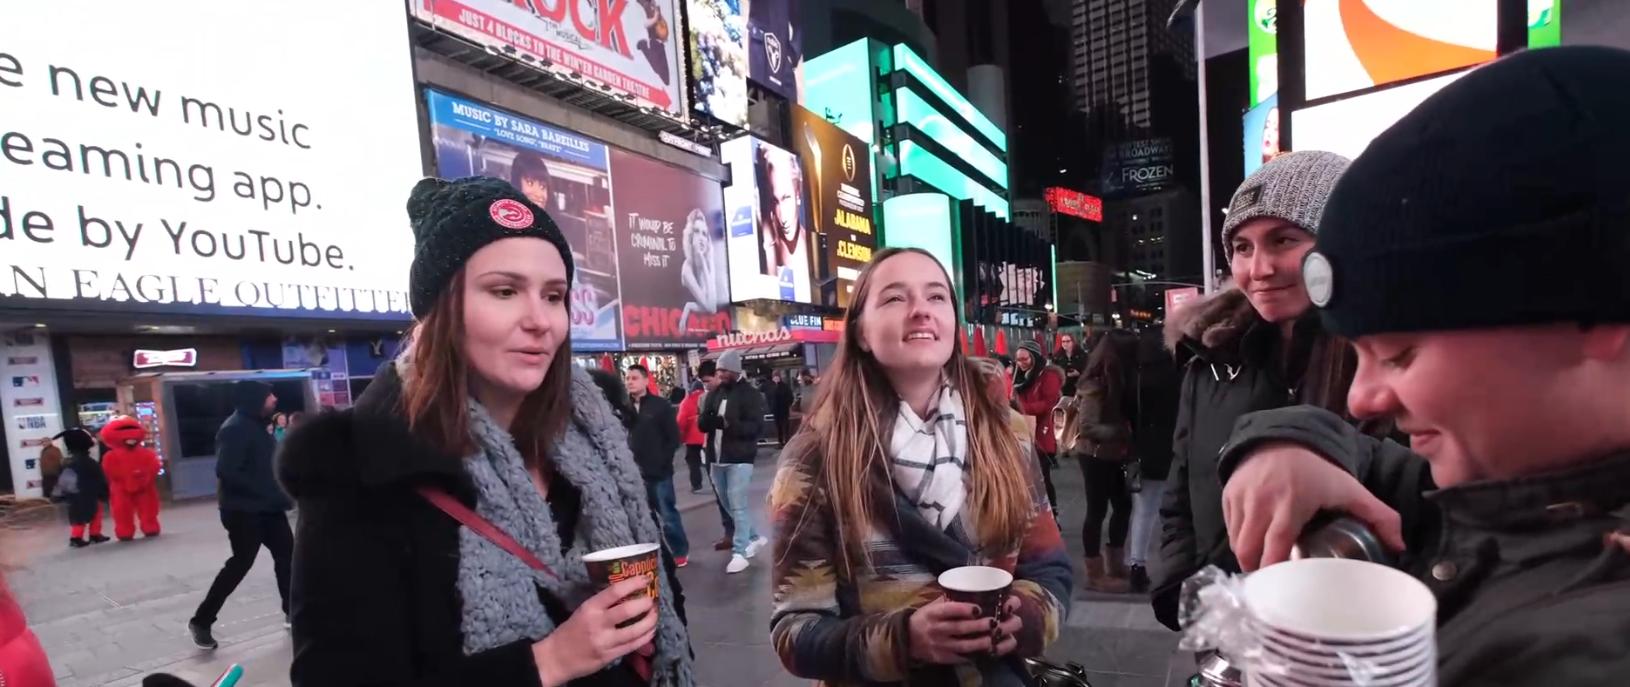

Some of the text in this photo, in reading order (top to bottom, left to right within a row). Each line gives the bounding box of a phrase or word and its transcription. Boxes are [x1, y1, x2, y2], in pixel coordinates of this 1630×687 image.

[458, 9, 484, 33] JUST
[486, 20, 495, 33] 4
[495, 22, 532, 49] BLOCKS
[533, 40, 545, 56] TO
[545, 43, 562, 64] THE
[49, 63, 161, 117] new
[181, 96, 311, 149] music
[452, 101, 590, 153] MUSIC BY SARA BAREILLES
[1122, 164, 1173, 183] FROZEN
[233, 171, 322, 214] app.
[78, 205, 142, 260] by
[161, 218, 354, 271] YouTube.
[628, 212, 674, 235] IT WOULD BE
[643, 252, 670, 268] MISS IT
[667, 238, 676, 251] TO
[71, 268, 220, 304] EAGLE
[809, 315, 822, 327] FIN
